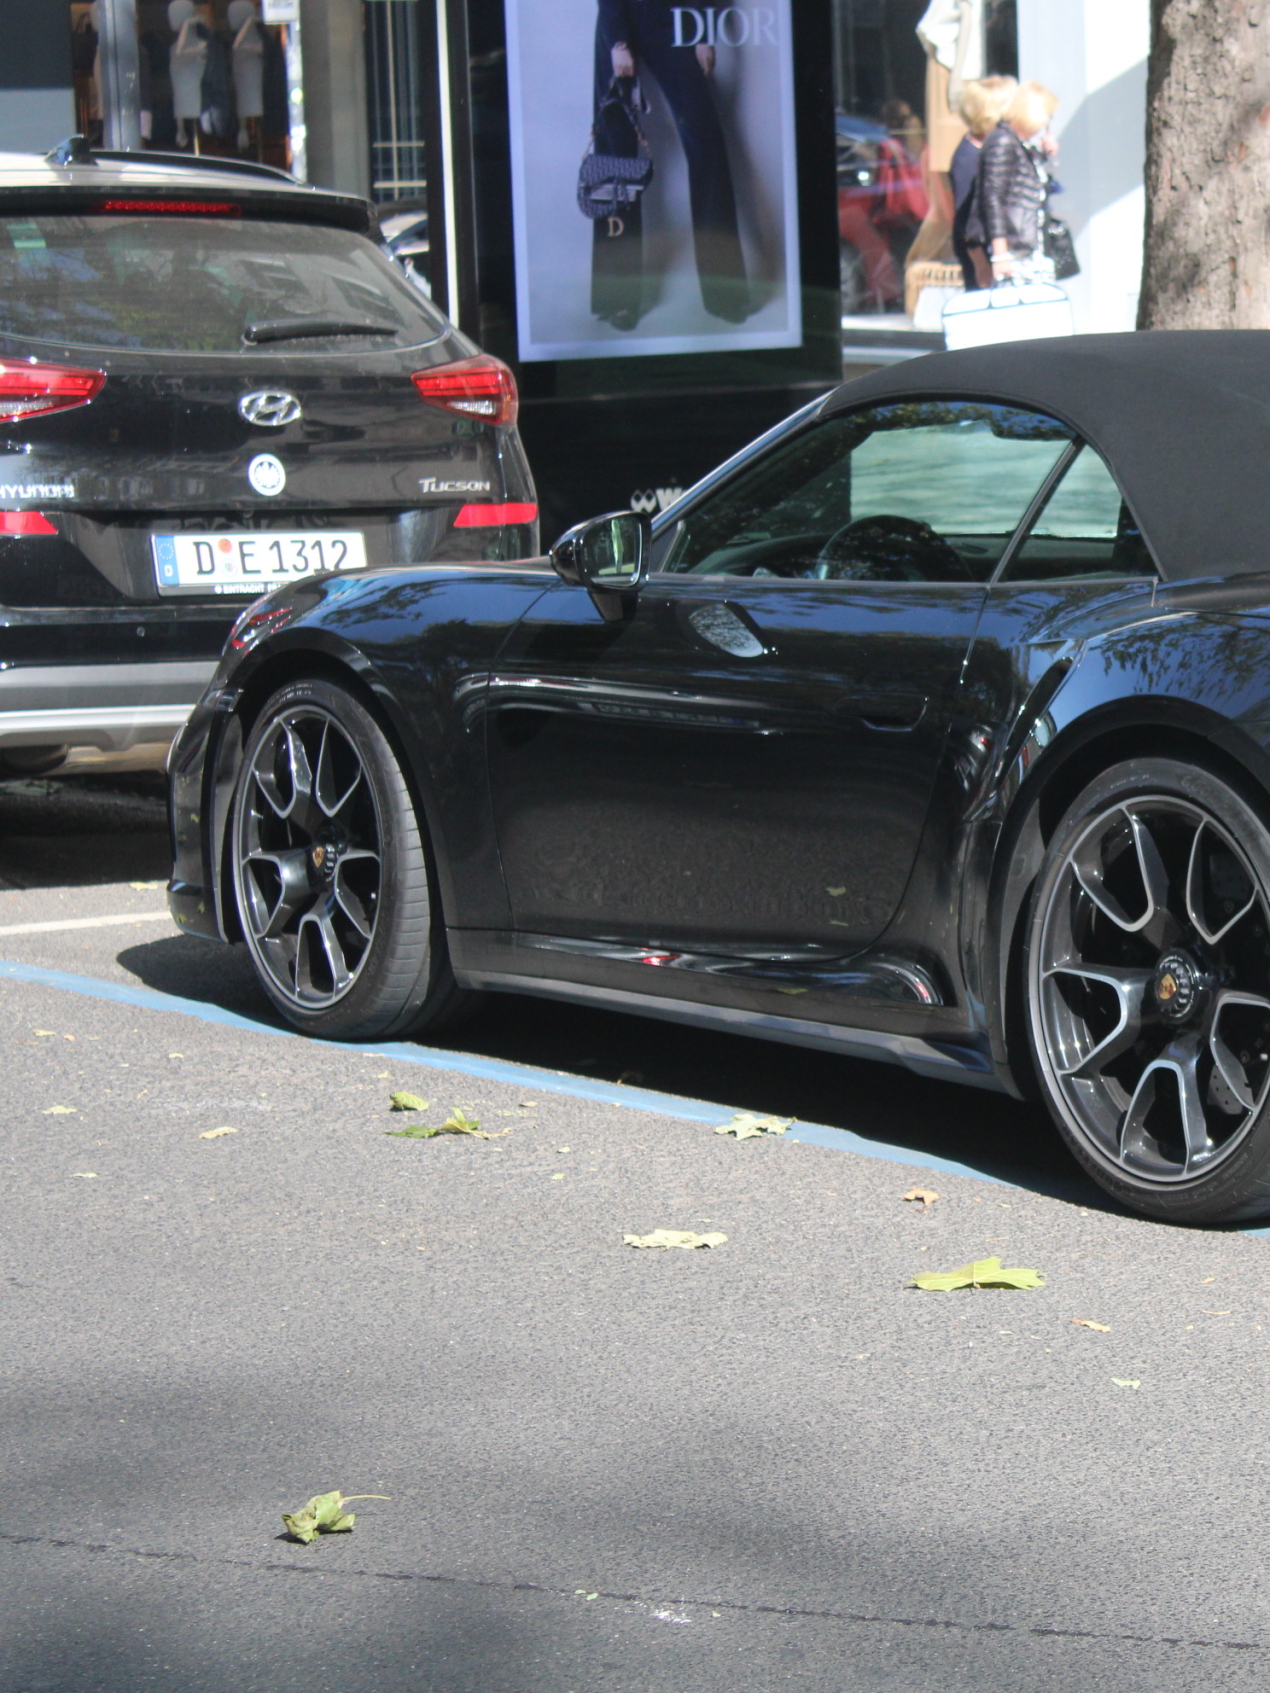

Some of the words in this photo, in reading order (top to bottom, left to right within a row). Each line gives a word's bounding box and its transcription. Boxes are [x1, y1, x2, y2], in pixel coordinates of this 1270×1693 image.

[670, 7, 779, 47] DIOR
[193, 541, 216, 575] D
[238, 541, 262, 574] E
[269, 539, 349, 574] 1312
